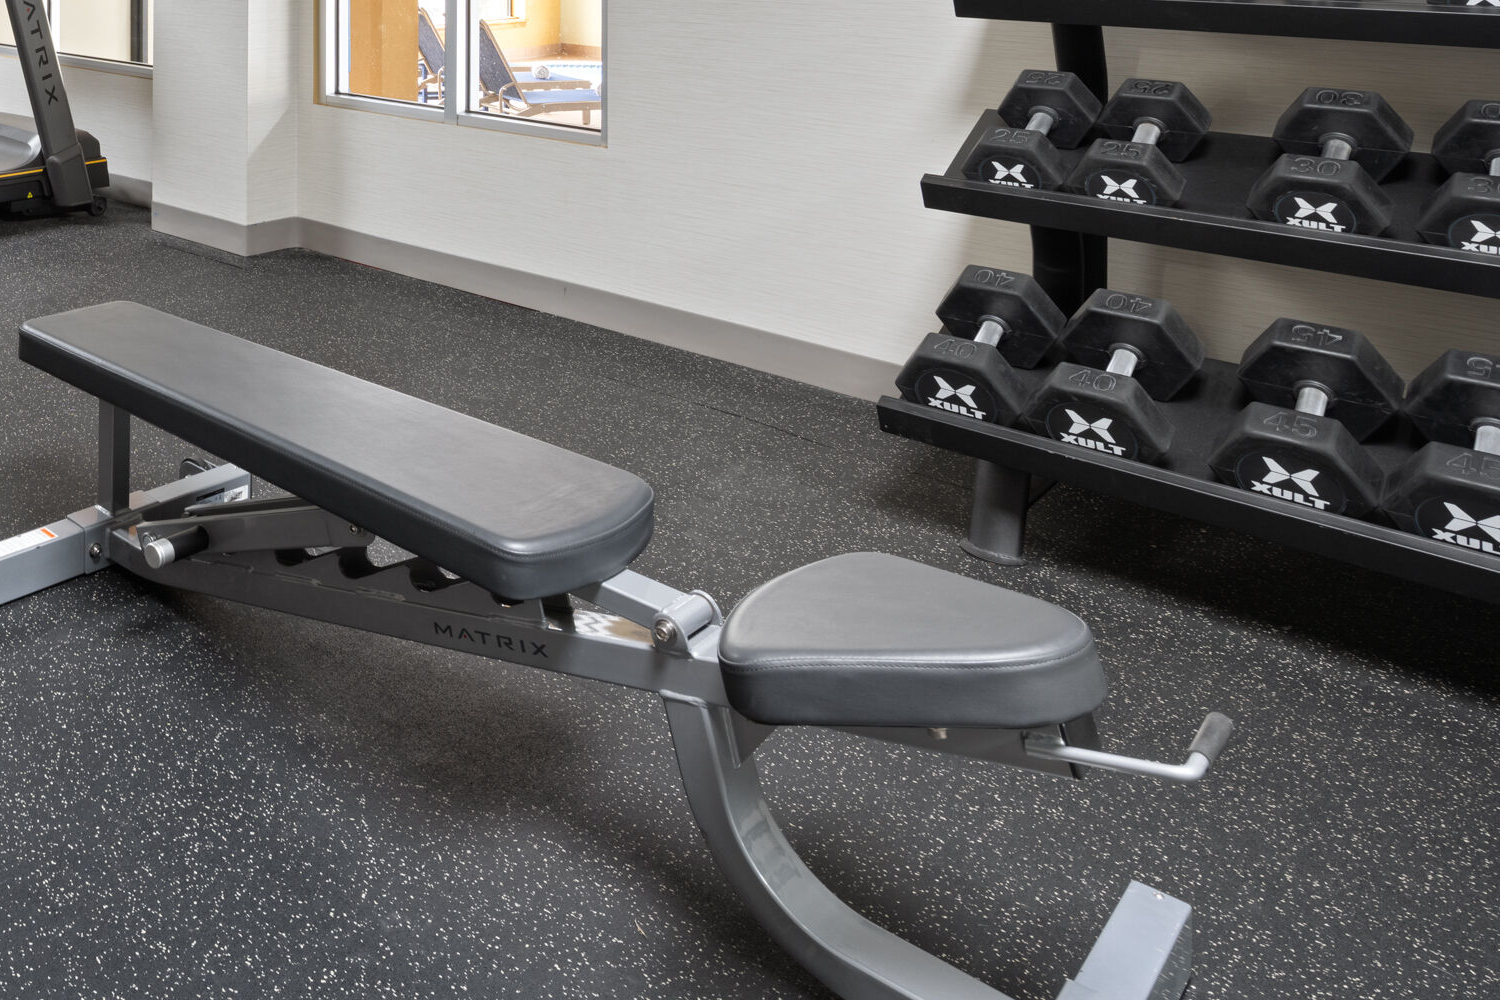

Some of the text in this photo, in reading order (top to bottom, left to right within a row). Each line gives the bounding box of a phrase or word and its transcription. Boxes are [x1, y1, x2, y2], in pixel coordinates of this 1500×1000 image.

[1315, 90, 1364, 105] 30
[990, 128, 1029, 144] 25
[1100, 141, 1141, 159] 25
[1291, 157, 1341, 176] 30
[1286, 217, 1346, 233] XULT
[1461, 241, 1500, 255] XU
[974, 269, 1015, 290] 40
[1105, 294, 1152, 314] 40
[1291, 324, 1343, 347] 45
[933, 339, 977, 360] 40
[1068, 369, 1117, 392] 40
[927, 396, 987, 421] XULT
[1263, 412, 1318, 439] 45
[1059, 432, 1127, 457] XULT
[1251, 480, 1331, 511] XULT
[433, 621, 549, 658] MATRIX
